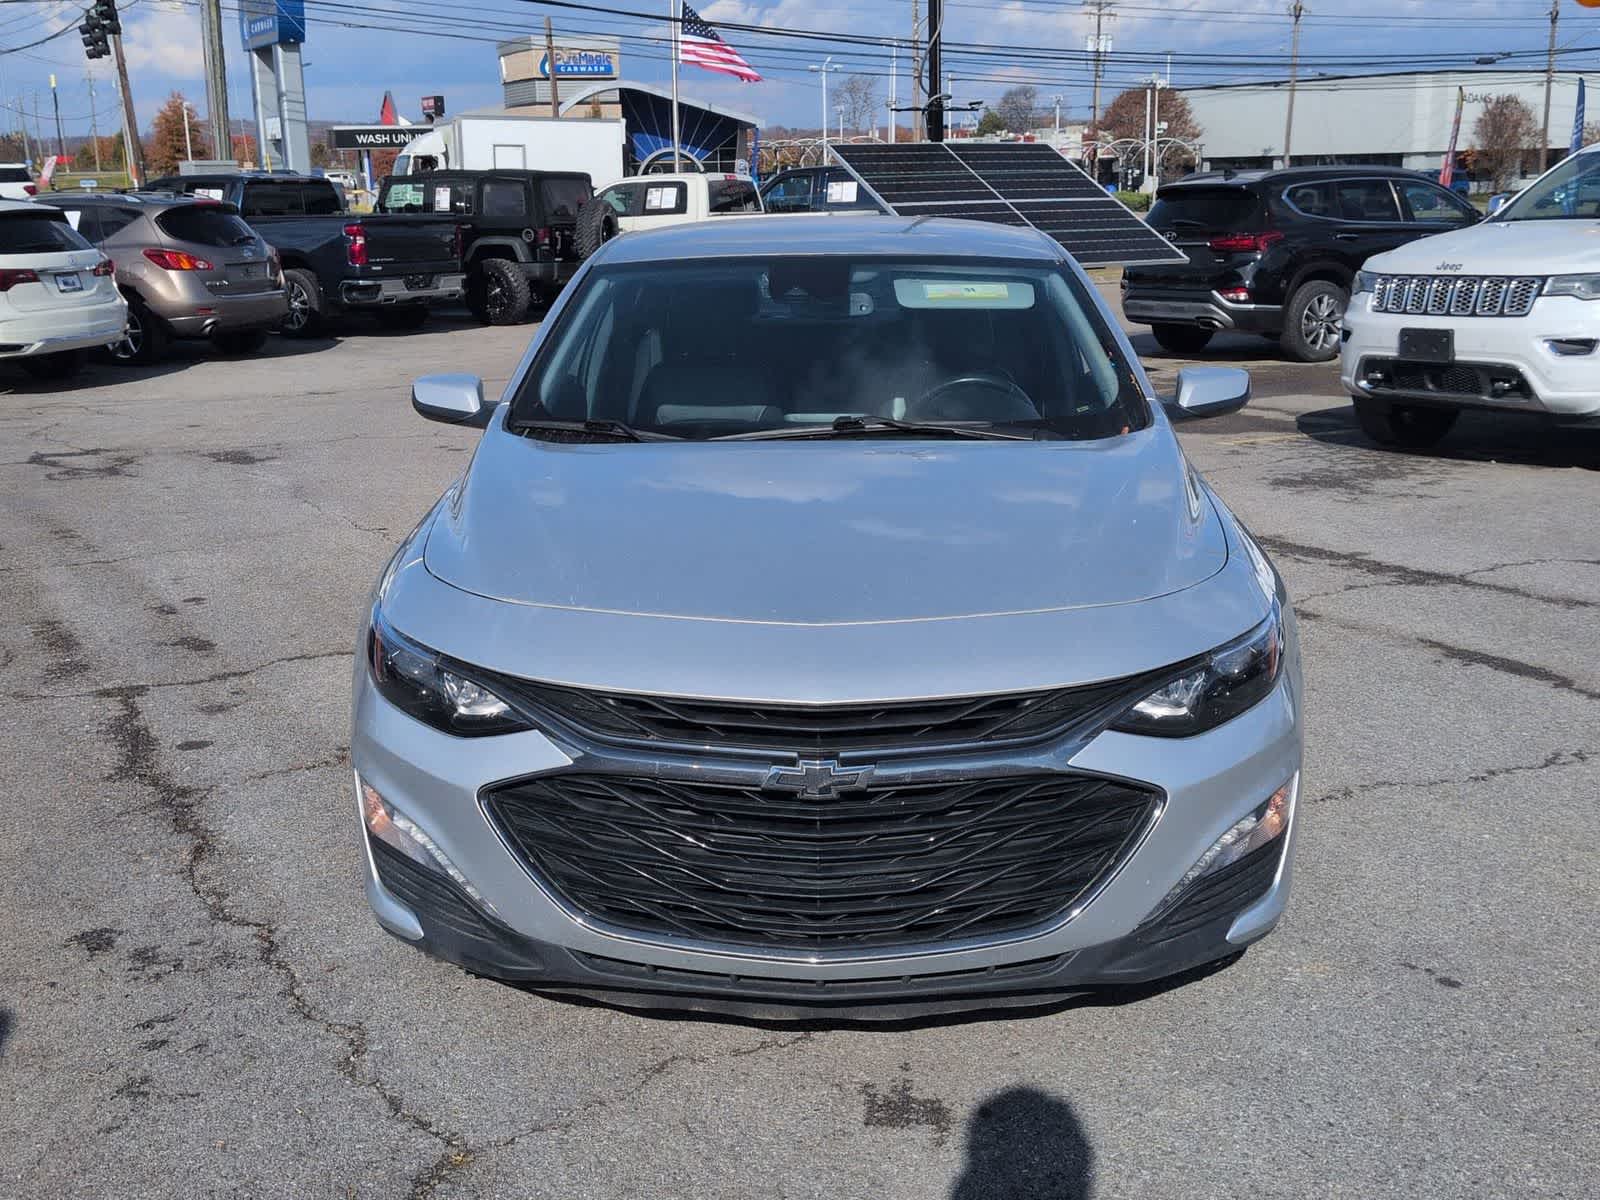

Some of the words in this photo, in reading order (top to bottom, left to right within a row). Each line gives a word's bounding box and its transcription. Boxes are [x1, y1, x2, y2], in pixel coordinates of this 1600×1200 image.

[554, 52, 612, 65] PureMagic
[356, 134, 390, 144] WASH
[1436, 260, 1464, 272] Jeep
